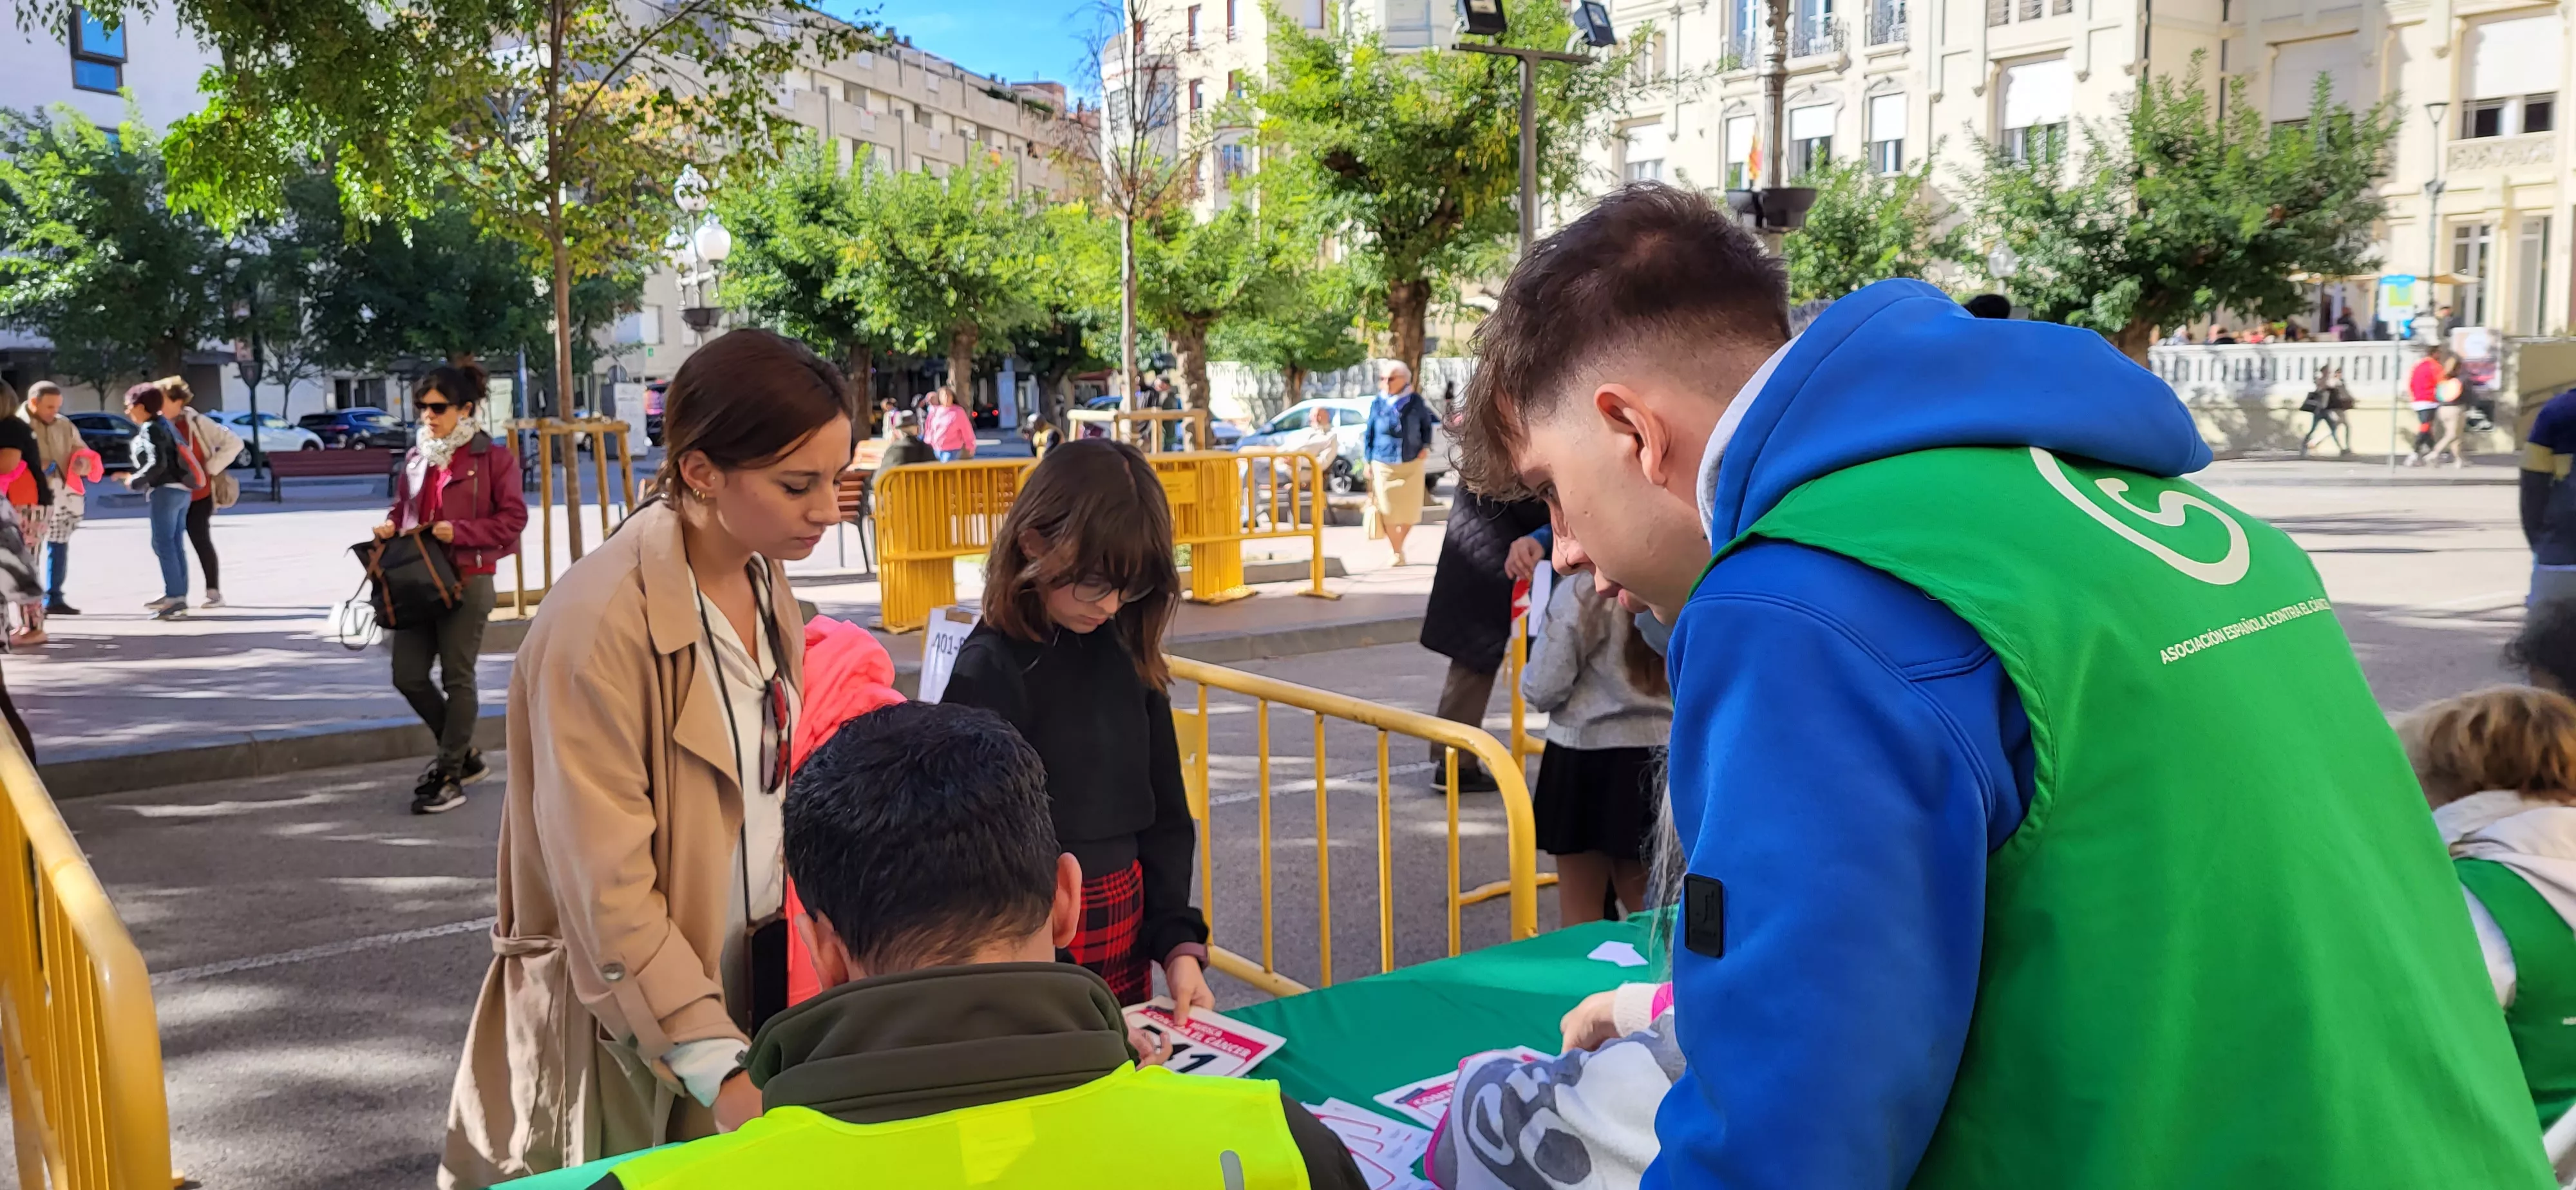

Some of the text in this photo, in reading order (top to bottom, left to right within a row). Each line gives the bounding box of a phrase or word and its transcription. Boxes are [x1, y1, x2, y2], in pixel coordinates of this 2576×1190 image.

[2160, 628, 2228, 665] ASOCIACIÓN
[2222, 617, 2271, 640] ESPAÑOLA
[2266, 605, 2304, 626] CONTRA
[2297, 601, 2313, 615] EL
[1203, 1037, 1252, 1057] CÁNCER
